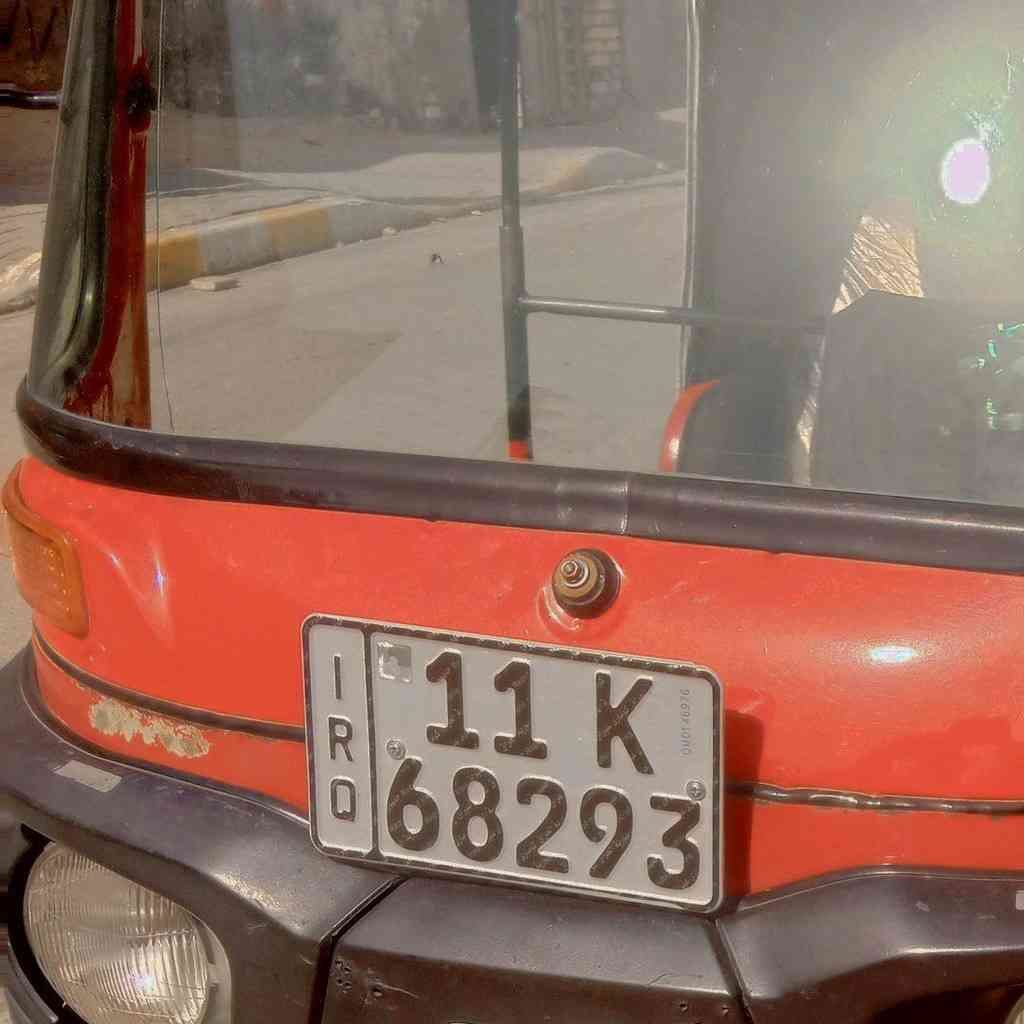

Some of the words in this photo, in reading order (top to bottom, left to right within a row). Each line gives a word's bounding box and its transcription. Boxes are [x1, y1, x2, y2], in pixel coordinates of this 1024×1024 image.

[327, 654, 357, 822] IRQ
[425, 649, 548, 760] 11
[595, 670, 655, 775] K
[386, 757, 701, 890] 68293
